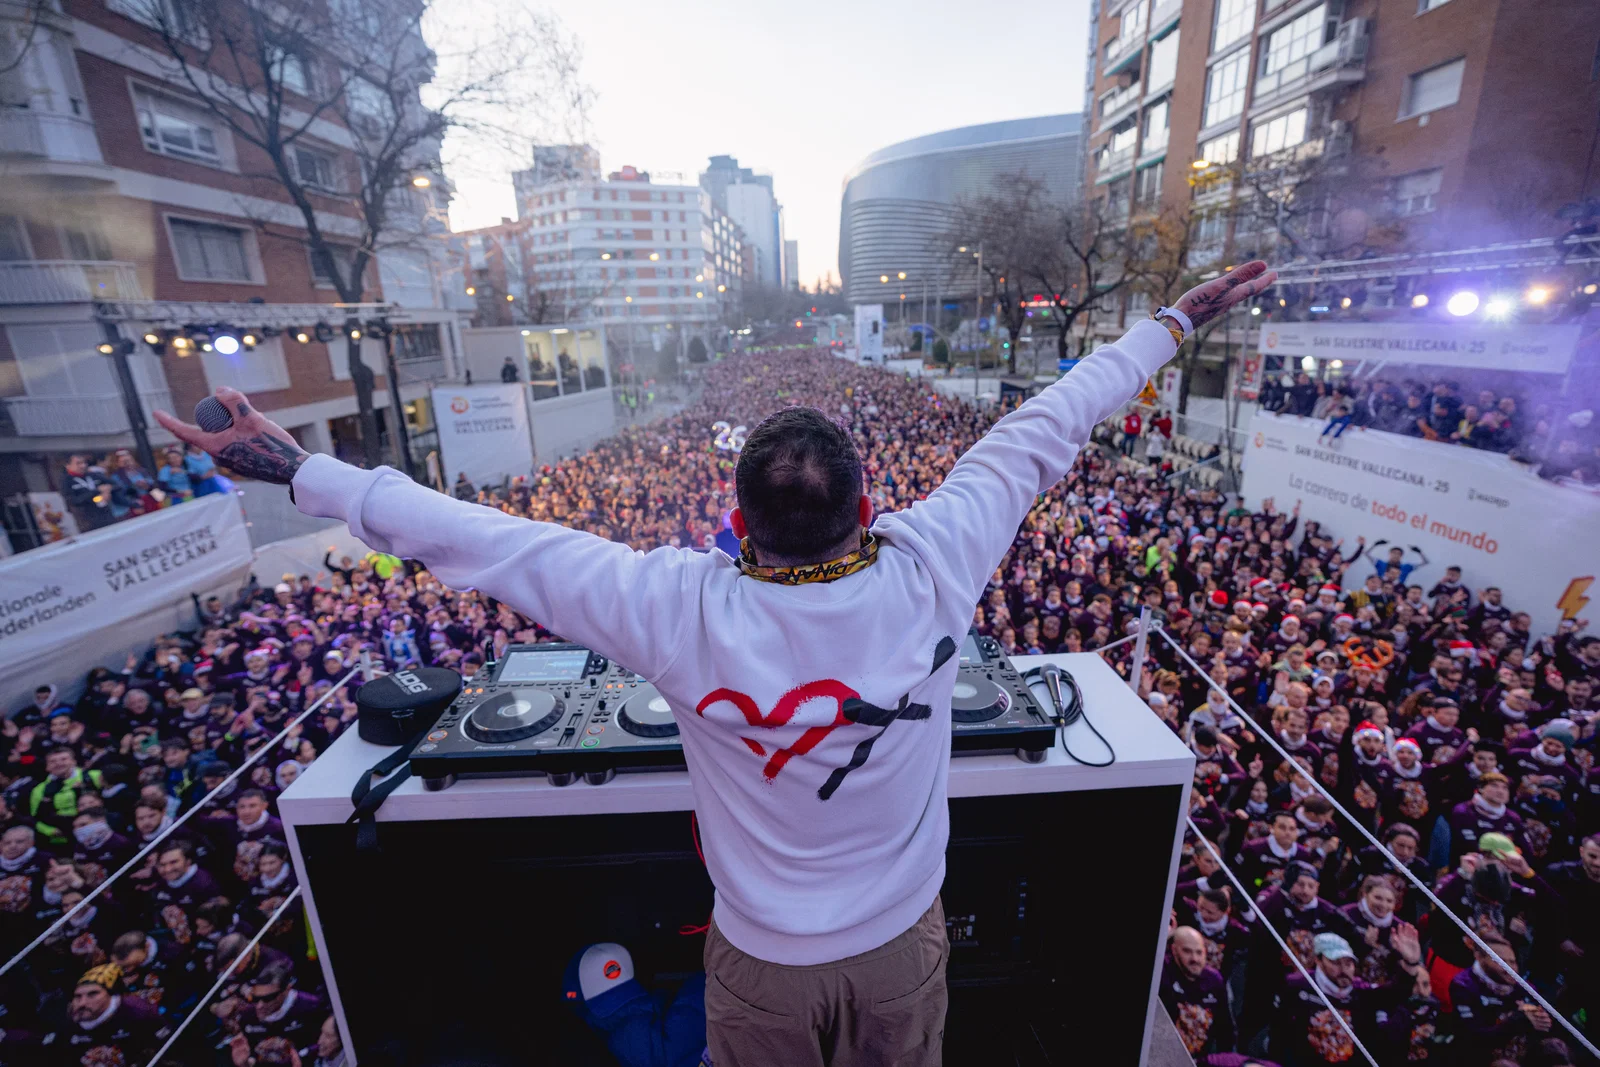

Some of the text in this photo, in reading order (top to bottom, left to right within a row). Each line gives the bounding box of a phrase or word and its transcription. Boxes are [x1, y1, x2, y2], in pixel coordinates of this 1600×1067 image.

[1313, 448, 1360, 470] SILVESTRE
[1361, 460, 1425, 488] VALLECANA
[1434, 479, 1450, 494] 25
[1288, 471, 1499, 554] La carrera de todo el mundo
[103, 525, 215, 578] SAN SILVESTRE
[107, 540, 218, 592] VALLECANA
[0, 592, 97, 640] derlanden
[395, 670, 429, 694] UDG
